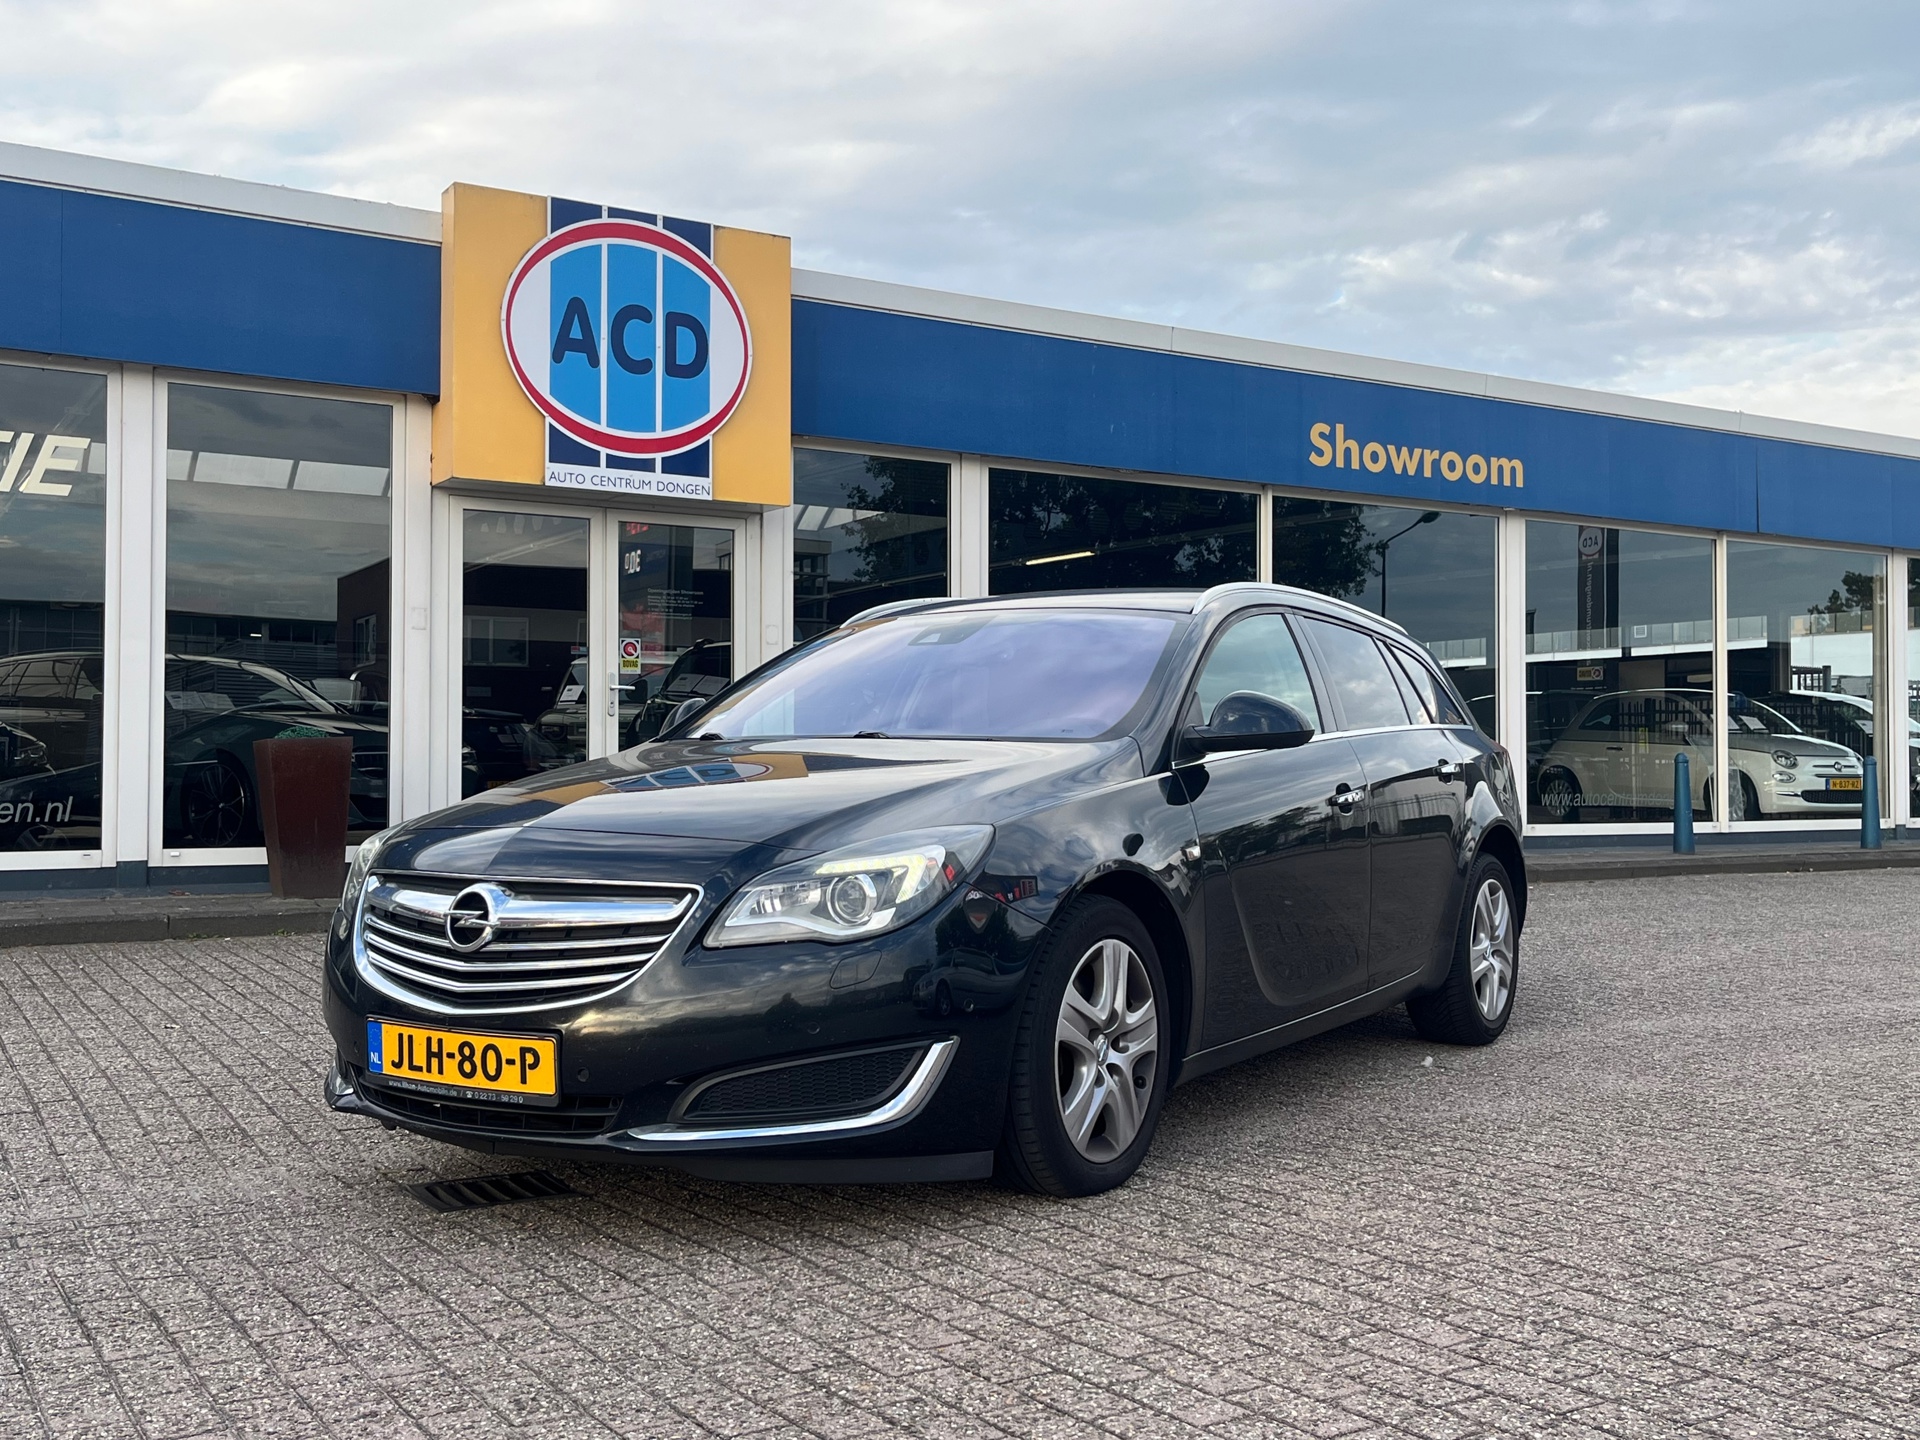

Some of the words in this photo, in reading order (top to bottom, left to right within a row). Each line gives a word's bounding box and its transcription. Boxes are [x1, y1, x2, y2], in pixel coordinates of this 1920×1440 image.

[551, 296, 709, 379] ACD
[1308, 422, 1524, 488] Showroom
[548, 471, 586, 484] AUTO
[590, 474, 652, 491] CENTRUM
[656, 480, 711, 495] DONGEN
[622, 660, 639, 668] BOVAG
[370, 1052, 382, 1064] NL
[391, 1033, 541, 1085] JLH-80-P
